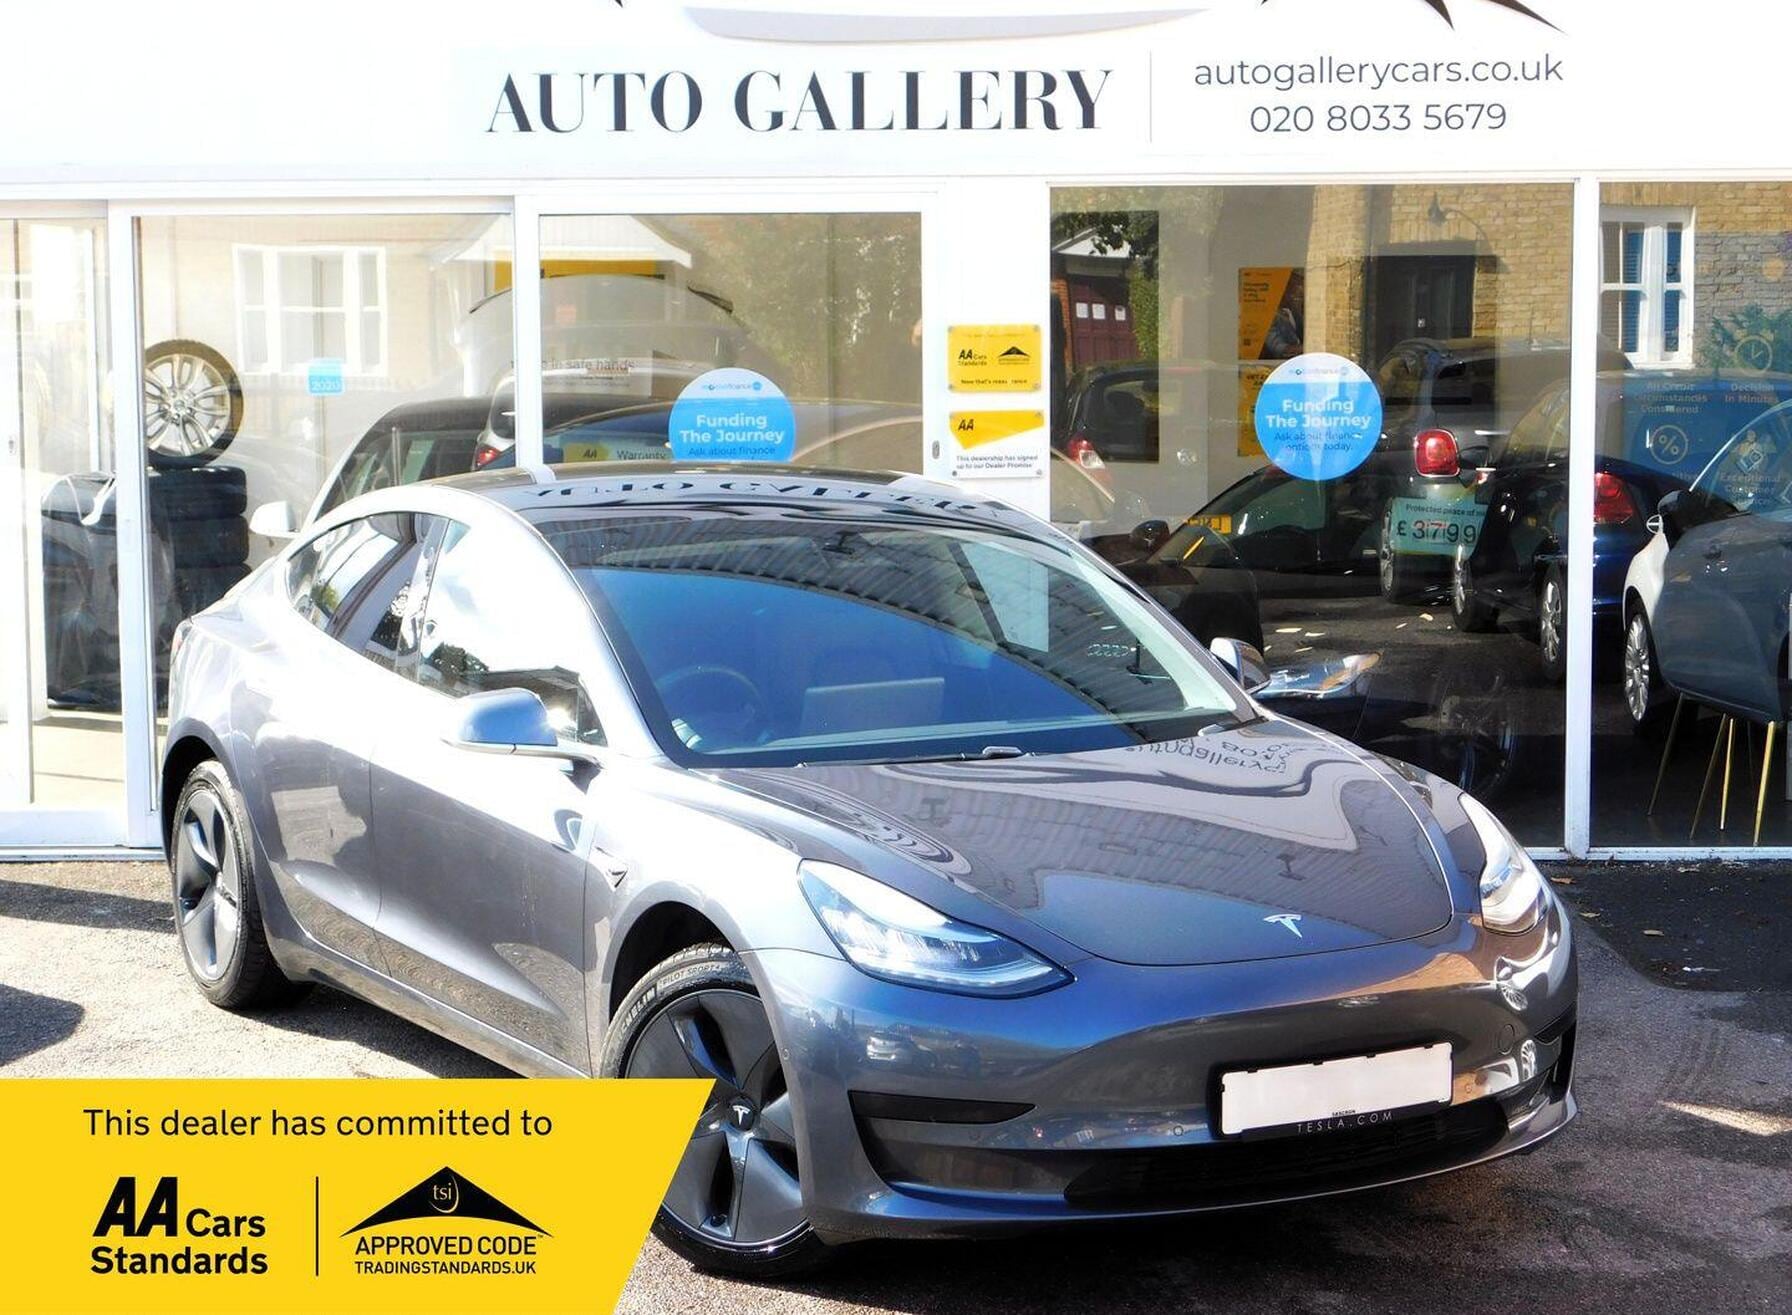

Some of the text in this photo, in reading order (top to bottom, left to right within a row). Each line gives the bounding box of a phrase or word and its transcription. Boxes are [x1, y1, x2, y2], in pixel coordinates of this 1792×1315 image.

[1194, 53, 1564, 91] autogallerycars.co.uk
[486, 69, 1113, 134] AUTO GALLERY
[1250, 103, 1507, 133] 020 8033 5679
[958, 348, 974, 360] AA
[1282, 399, 1355, 414] Funding
[695, 412, 768, 430] Funding
[958, 418, 975, 431] AA
[1265, 414, 1372, 430] The Journey
[680, 429, 785, 446] The Journey
[1274, 431, 1292, 441] Ask
[688, 445, 776, 457] Ask about finance
[1296, 1110, 1393, 1134] TESLA.COM
